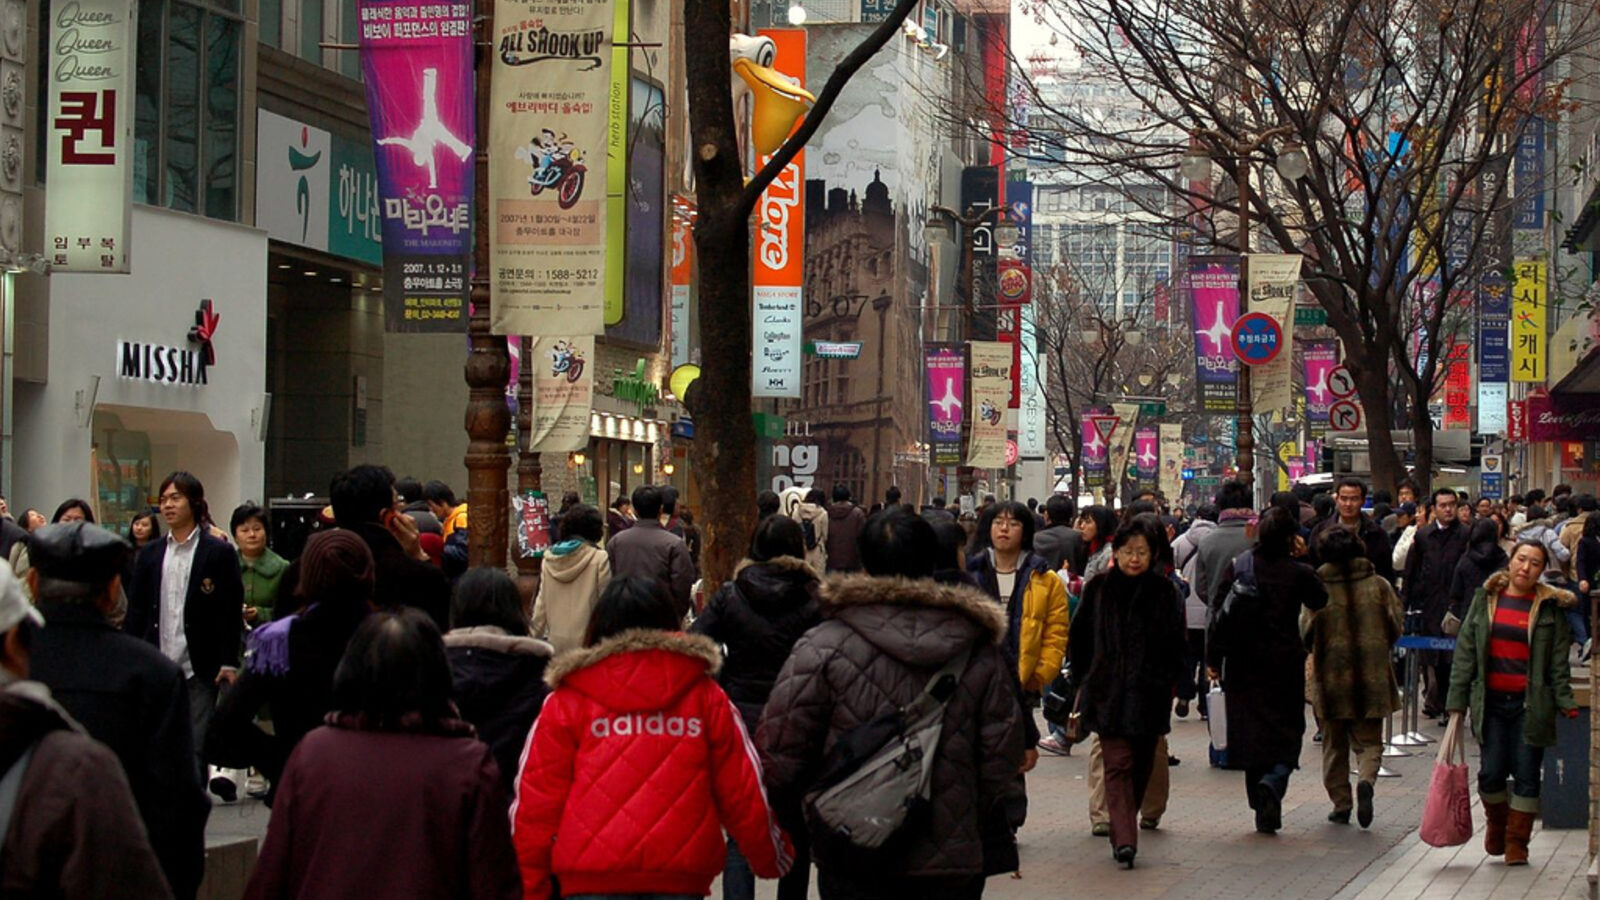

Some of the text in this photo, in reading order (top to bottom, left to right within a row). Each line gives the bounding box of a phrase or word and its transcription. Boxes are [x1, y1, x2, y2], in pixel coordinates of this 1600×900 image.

[57, 1, 116, 28] Queen
[56, 28, 119, 55] Queen
[364, 23, 391, 39] 비보이
[500, 26, 604, 58] ALL SHOOK UP
[55, 55, 120, 83] Queen
[506, 101, 558, 114] 에브리바디
[611, 82, 621, 120] station
[55, 89, 116, 165] 퀸
[499, 269, 535, 279] 공연문의
[546, 270, 599, 280] 1588-5212
[121, 341, 209, 385] MISSHA
[591, 711, 702, 738] adidas
